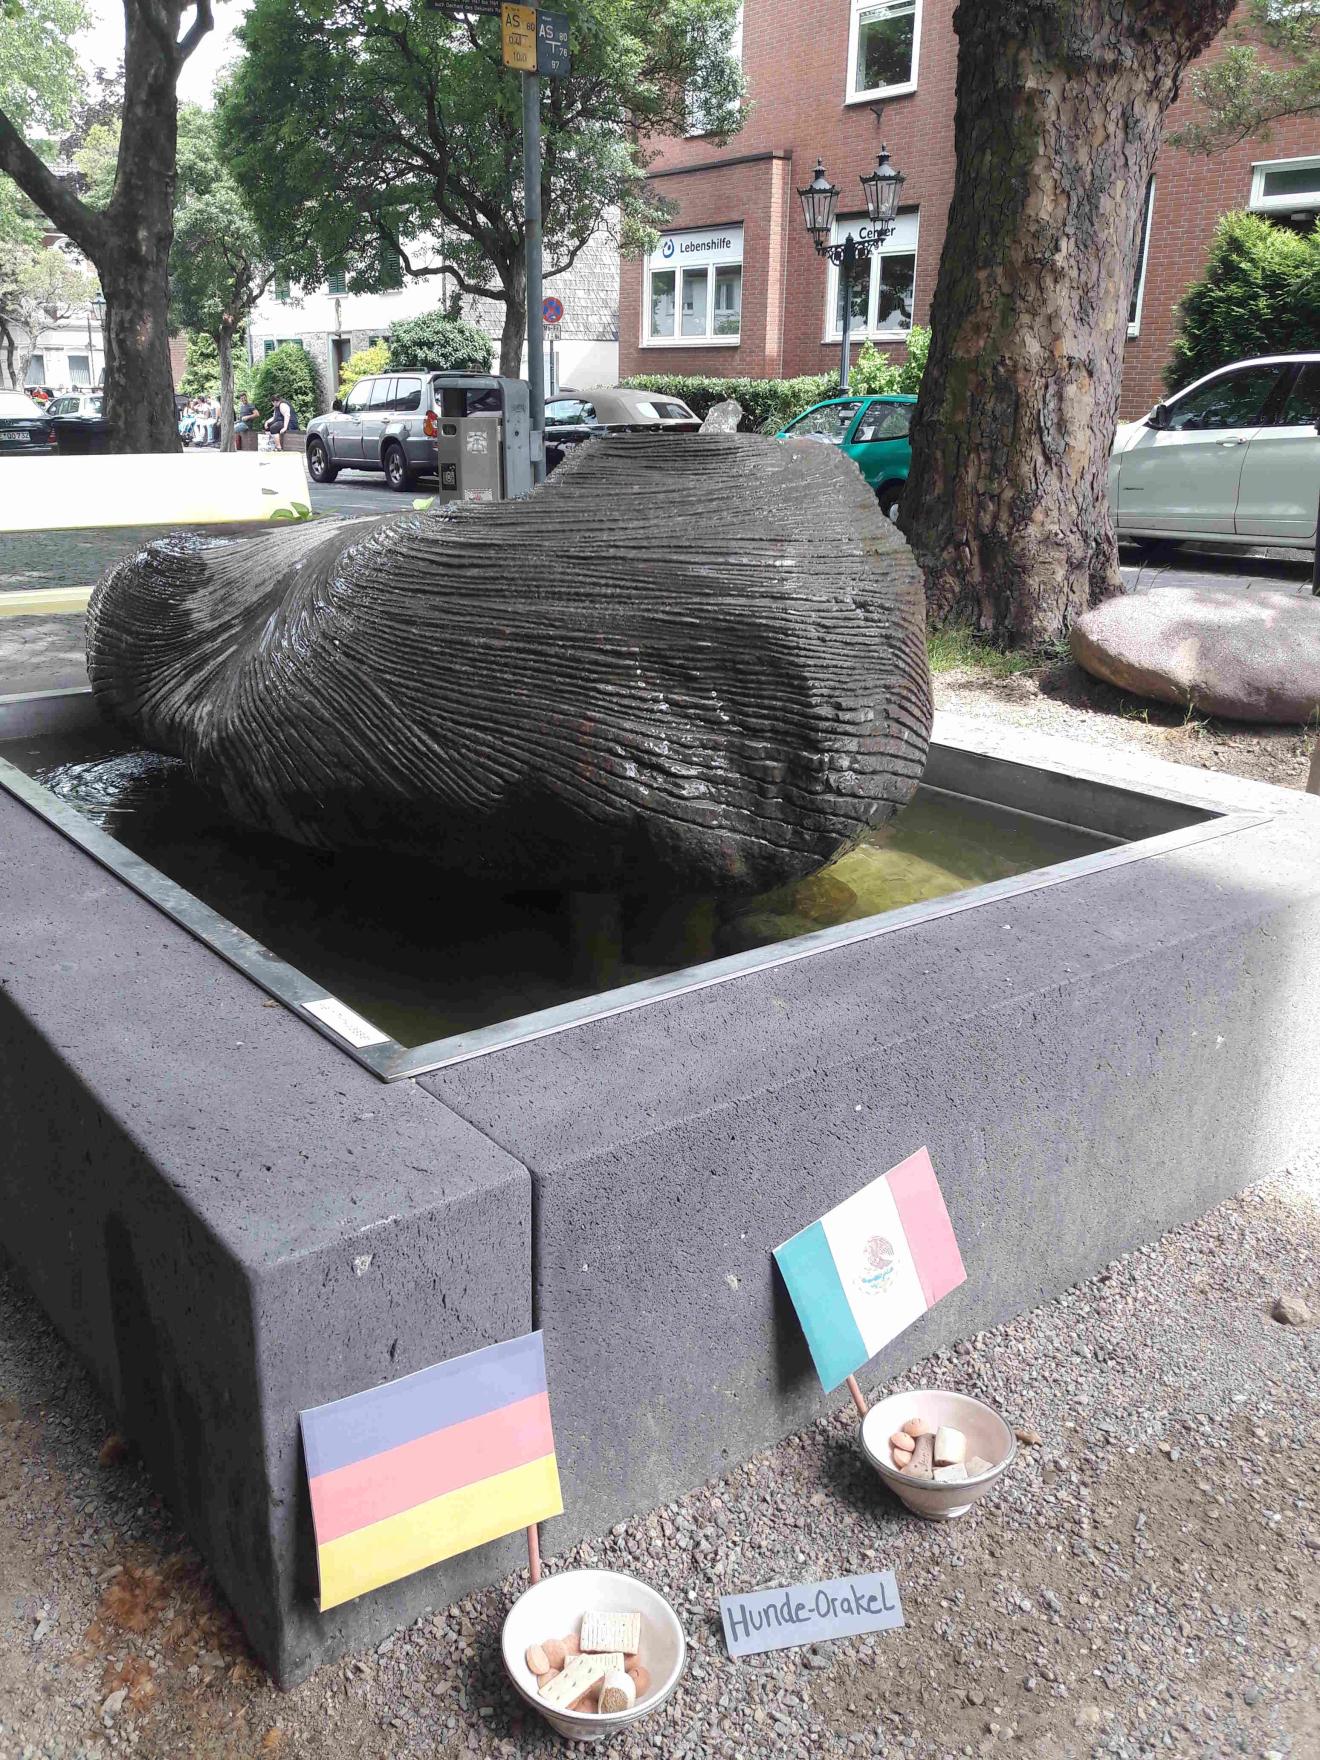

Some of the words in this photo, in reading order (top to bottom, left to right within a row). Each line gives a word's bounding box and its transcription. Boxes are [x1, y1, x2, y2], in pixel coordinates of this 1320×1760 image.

[506, 13, 520, 27] AS
[539, 24, 554, 38] AS
[680, 237, 731, 253] Lebenshilfe
